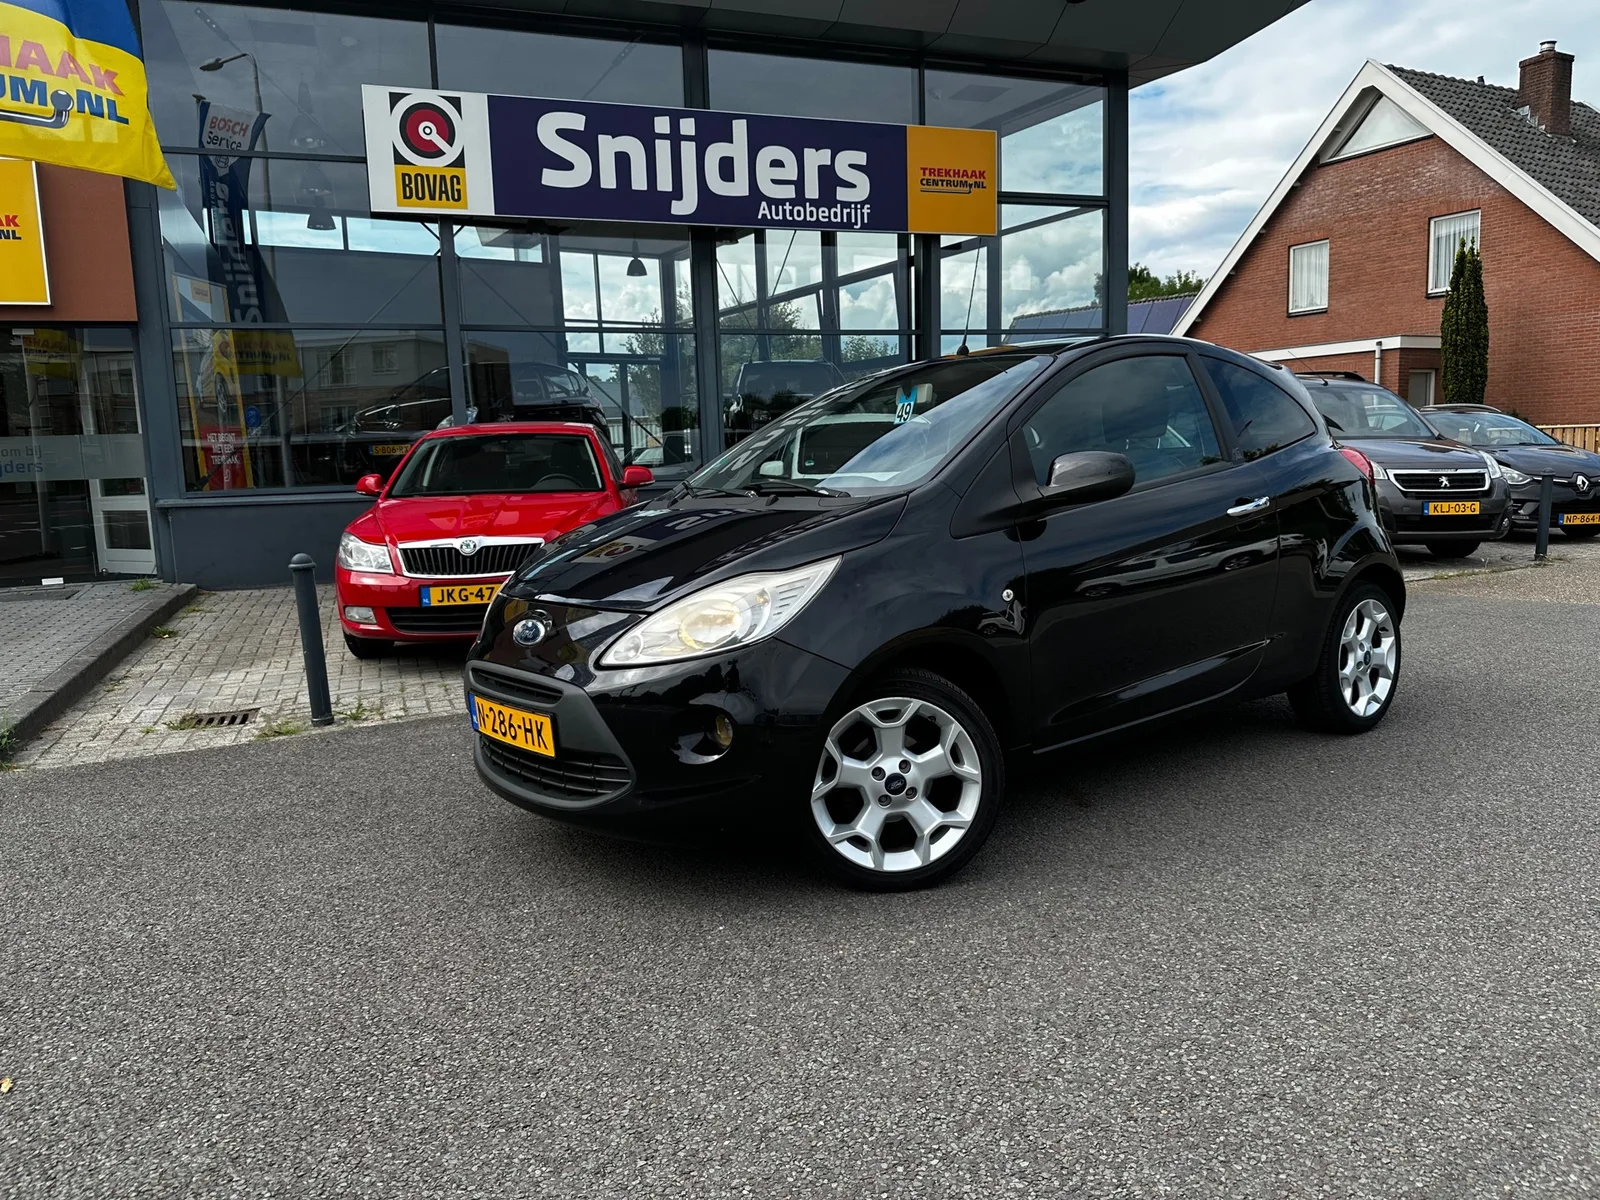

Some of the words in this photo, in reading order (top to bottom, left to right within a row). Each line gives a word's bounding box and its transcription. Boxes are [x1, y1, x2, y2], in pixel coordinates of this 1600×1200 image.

[209, 116, 250, 137] BOSCH
[206, 130, 242, 151] Service
[536, 111, 871, 216] Snijders
[920, 167, 987, 180] TREKHAAK
[401, 172, 462, 202] BOVAG
[757, 201, 871, 229] Autobedrijf
[896, 403, 912, 422] 49
[207, 433, 217, 442] HET
[218, 432, 236, 442] BEGINT
[25, 444, 42, 459] bij
[212, 444, 223, 453] MET
[224, 444, 235, 453] EEN
[1433, 503, 1476, 513] KLJ-03-G
[1565, 515, 1600, 523] NP-864-
[476, 702, 549, 750] N-286-HK
